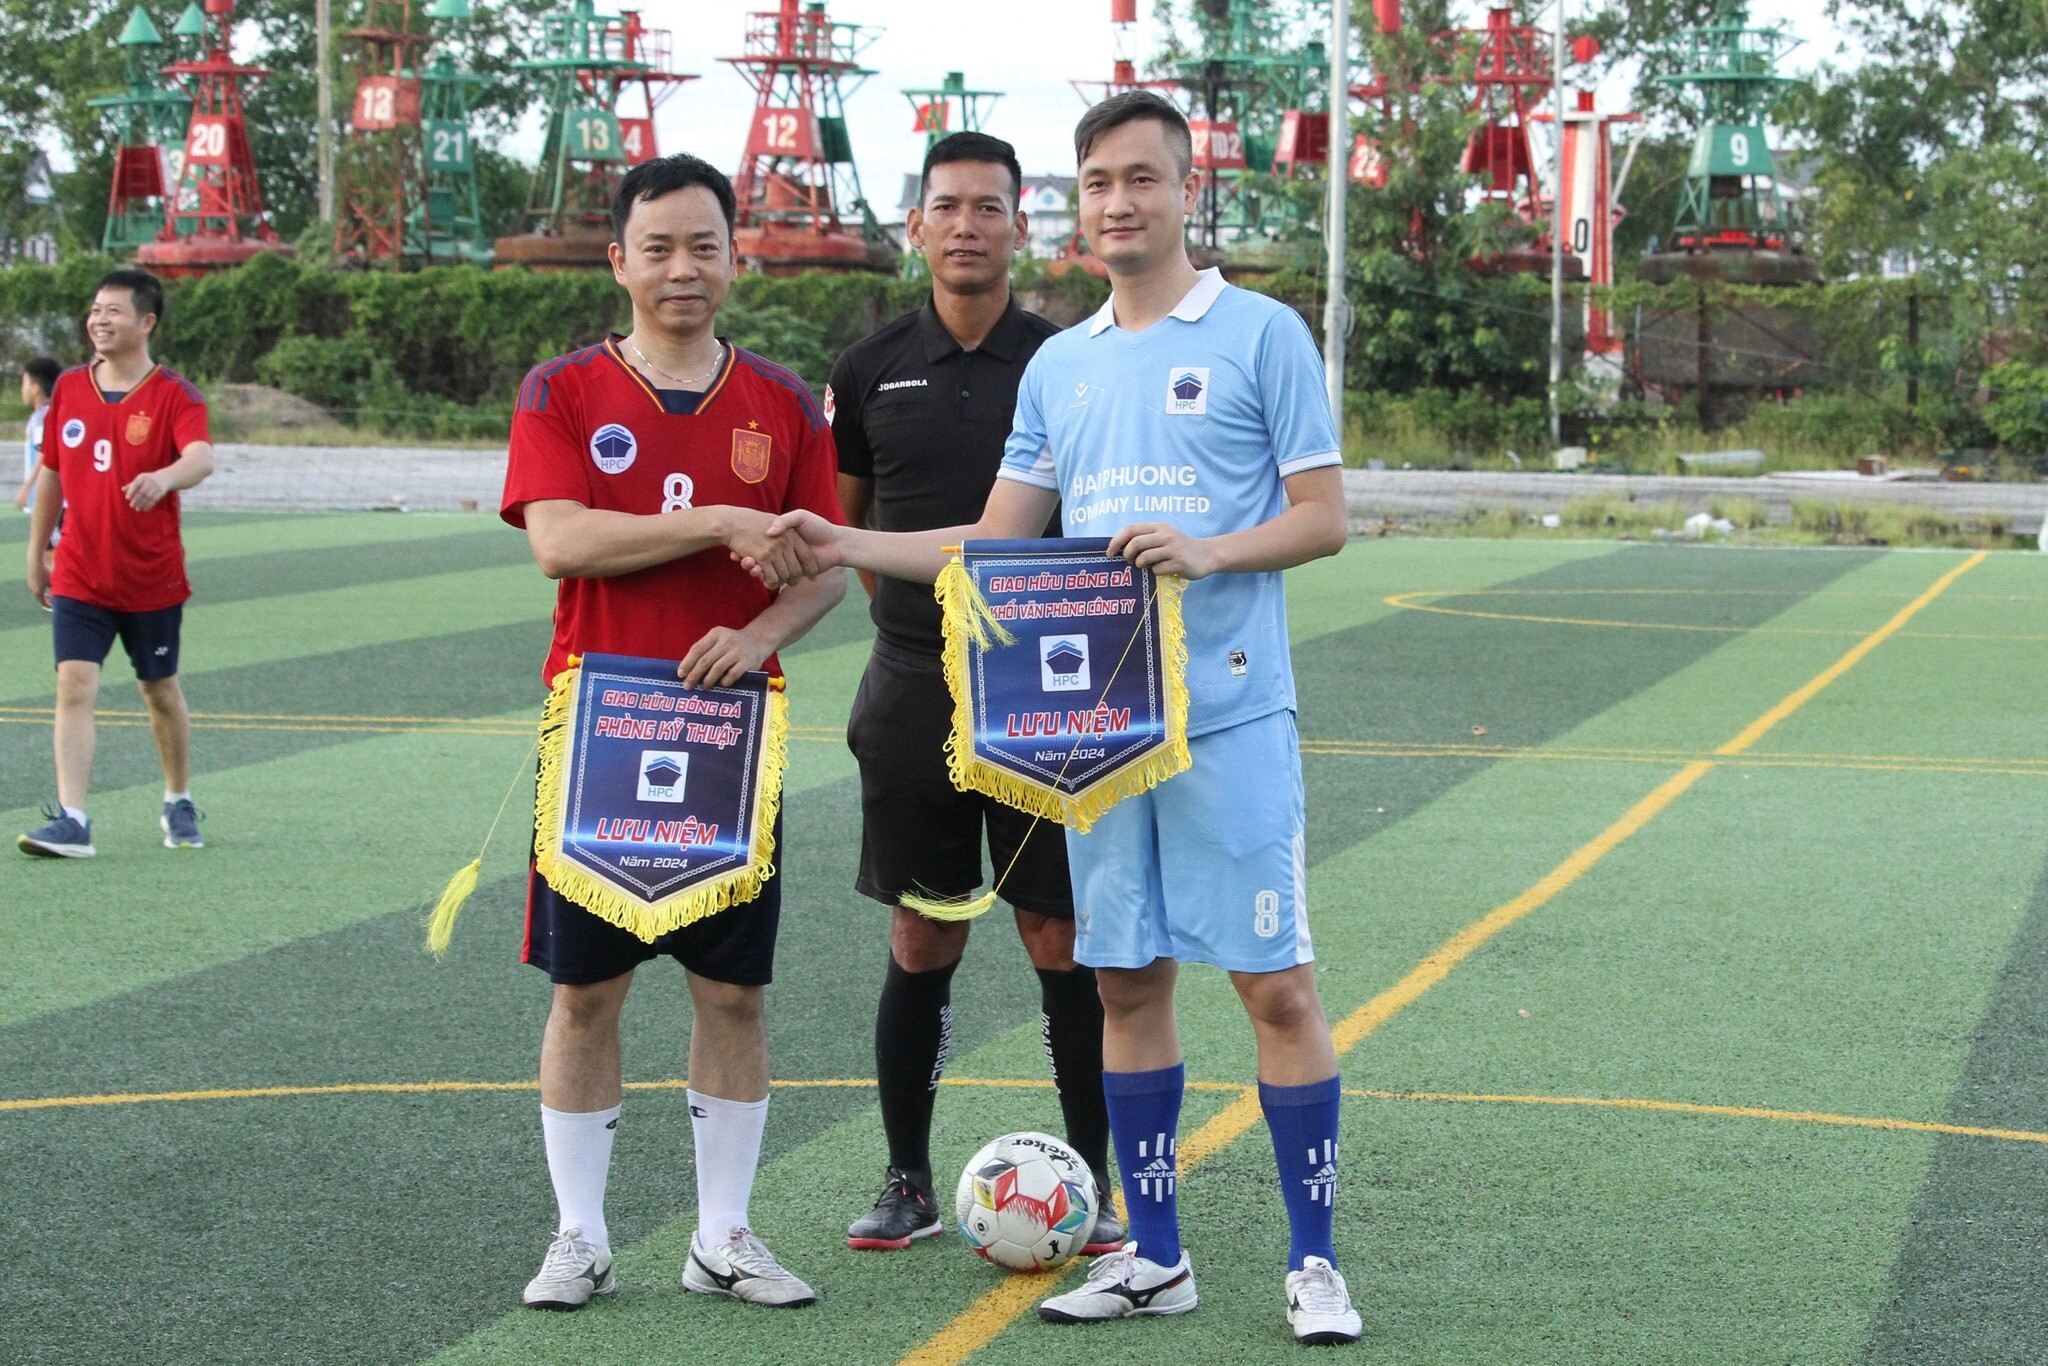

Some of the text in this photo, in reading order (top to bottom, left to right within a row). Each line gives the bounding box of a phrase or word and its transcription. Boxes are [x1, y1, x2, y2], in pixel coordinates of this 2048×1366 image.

[191, 123, 226, 157] 20
[576, 117, 610, 151] 13
[619, 124, 643, 157] 4
[762, 113, 799, 148] 12
[433, 129, 464, 163] 21
[1730, 132, 1750, 167] 9
[1575, 218, 1589, 253] 0
[878, 379, 928, 392] JOGARBOLA
[1175, 401, 1197, 410] HPC
[93, 439, 113, 472] 9
[600, 459, 627, 470] HPC
[1133, 496, 1210, 513] LIMITED
[989, 566, 1133, 593] GIAO HỮU BÓNG ĐÁ
[1020, 603, 1044, 620] VĂN
[1046, 598, 1086, 618] PHÒNG
[1088, 597, 1119, 616] CÔNG
[1120, 598, 1136, 614] TY
[1053, 675, 1079, 687] HPC
[601, 689, 742, 719] GIAO HỮU BÓNG ĐÁ
[595, 713, 743, 750] PHÒNG KỸ THUẬT
[1006, 701, 1131, 741] LƯU NIỆM
[1035, 747, 1106, 762] Năm 2024
[647, 787, 674, 798] HPC
[596, 815, 719, 851] LƯU NIỆM
[619, 855, 688, 869] Năm 2024
[1254, 889, 1279, 938] 8
[1132, 1170, 1176, 1179] adida
[1302, 1175, 1338, 1185] adid
